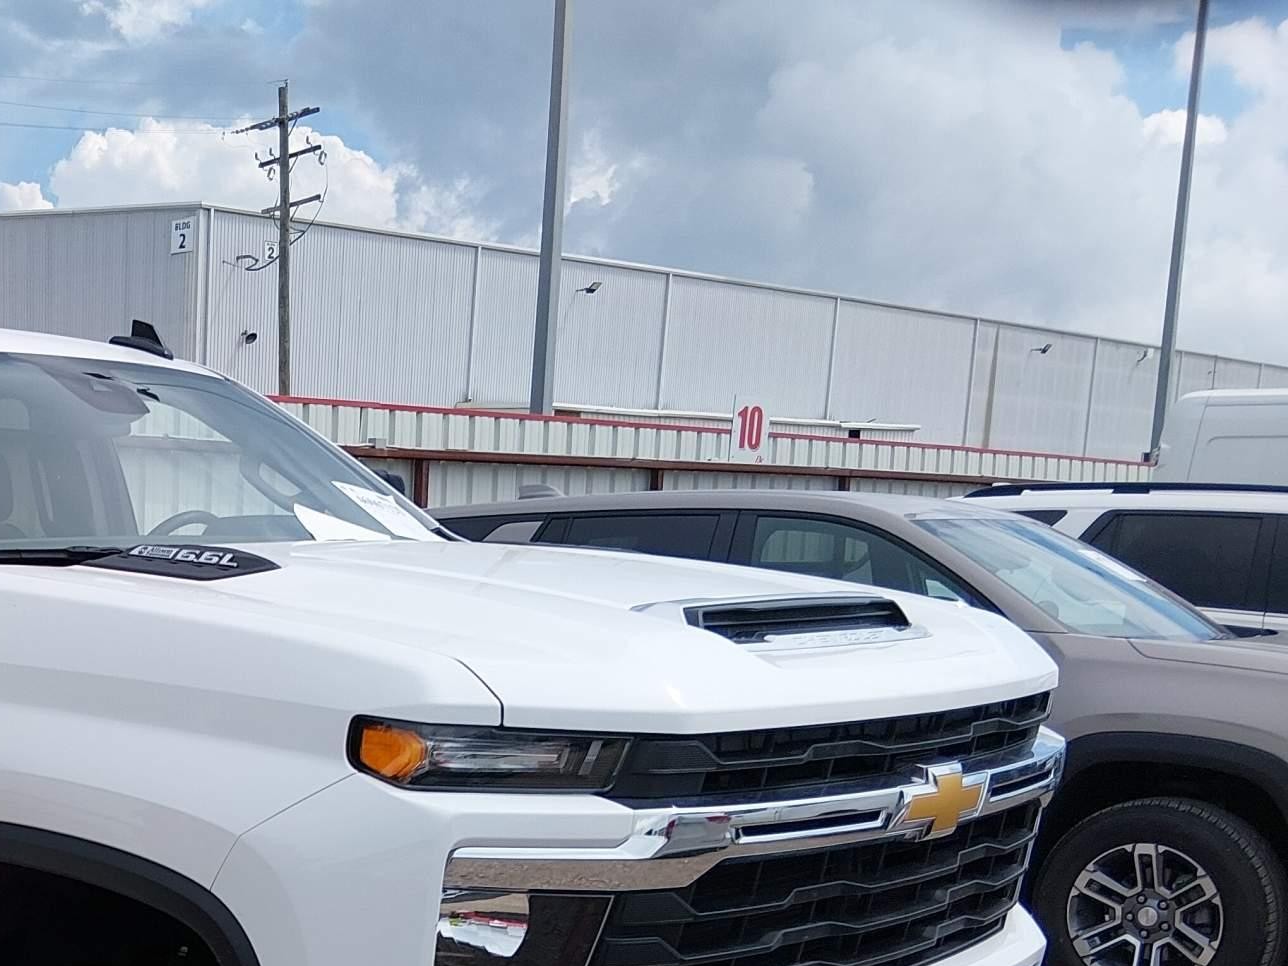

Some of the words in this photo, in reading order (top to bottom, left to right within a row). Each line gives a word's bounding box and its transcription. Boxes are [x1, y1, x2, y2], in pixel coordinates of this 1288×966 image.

[174, 221, 191, 231] BLDG
[178, 233, 186, 249] 2
[267, 246, 275, 259] 2
[737, 405, 763, 450] 10
[175, 548, 238, 568] 6.6L
